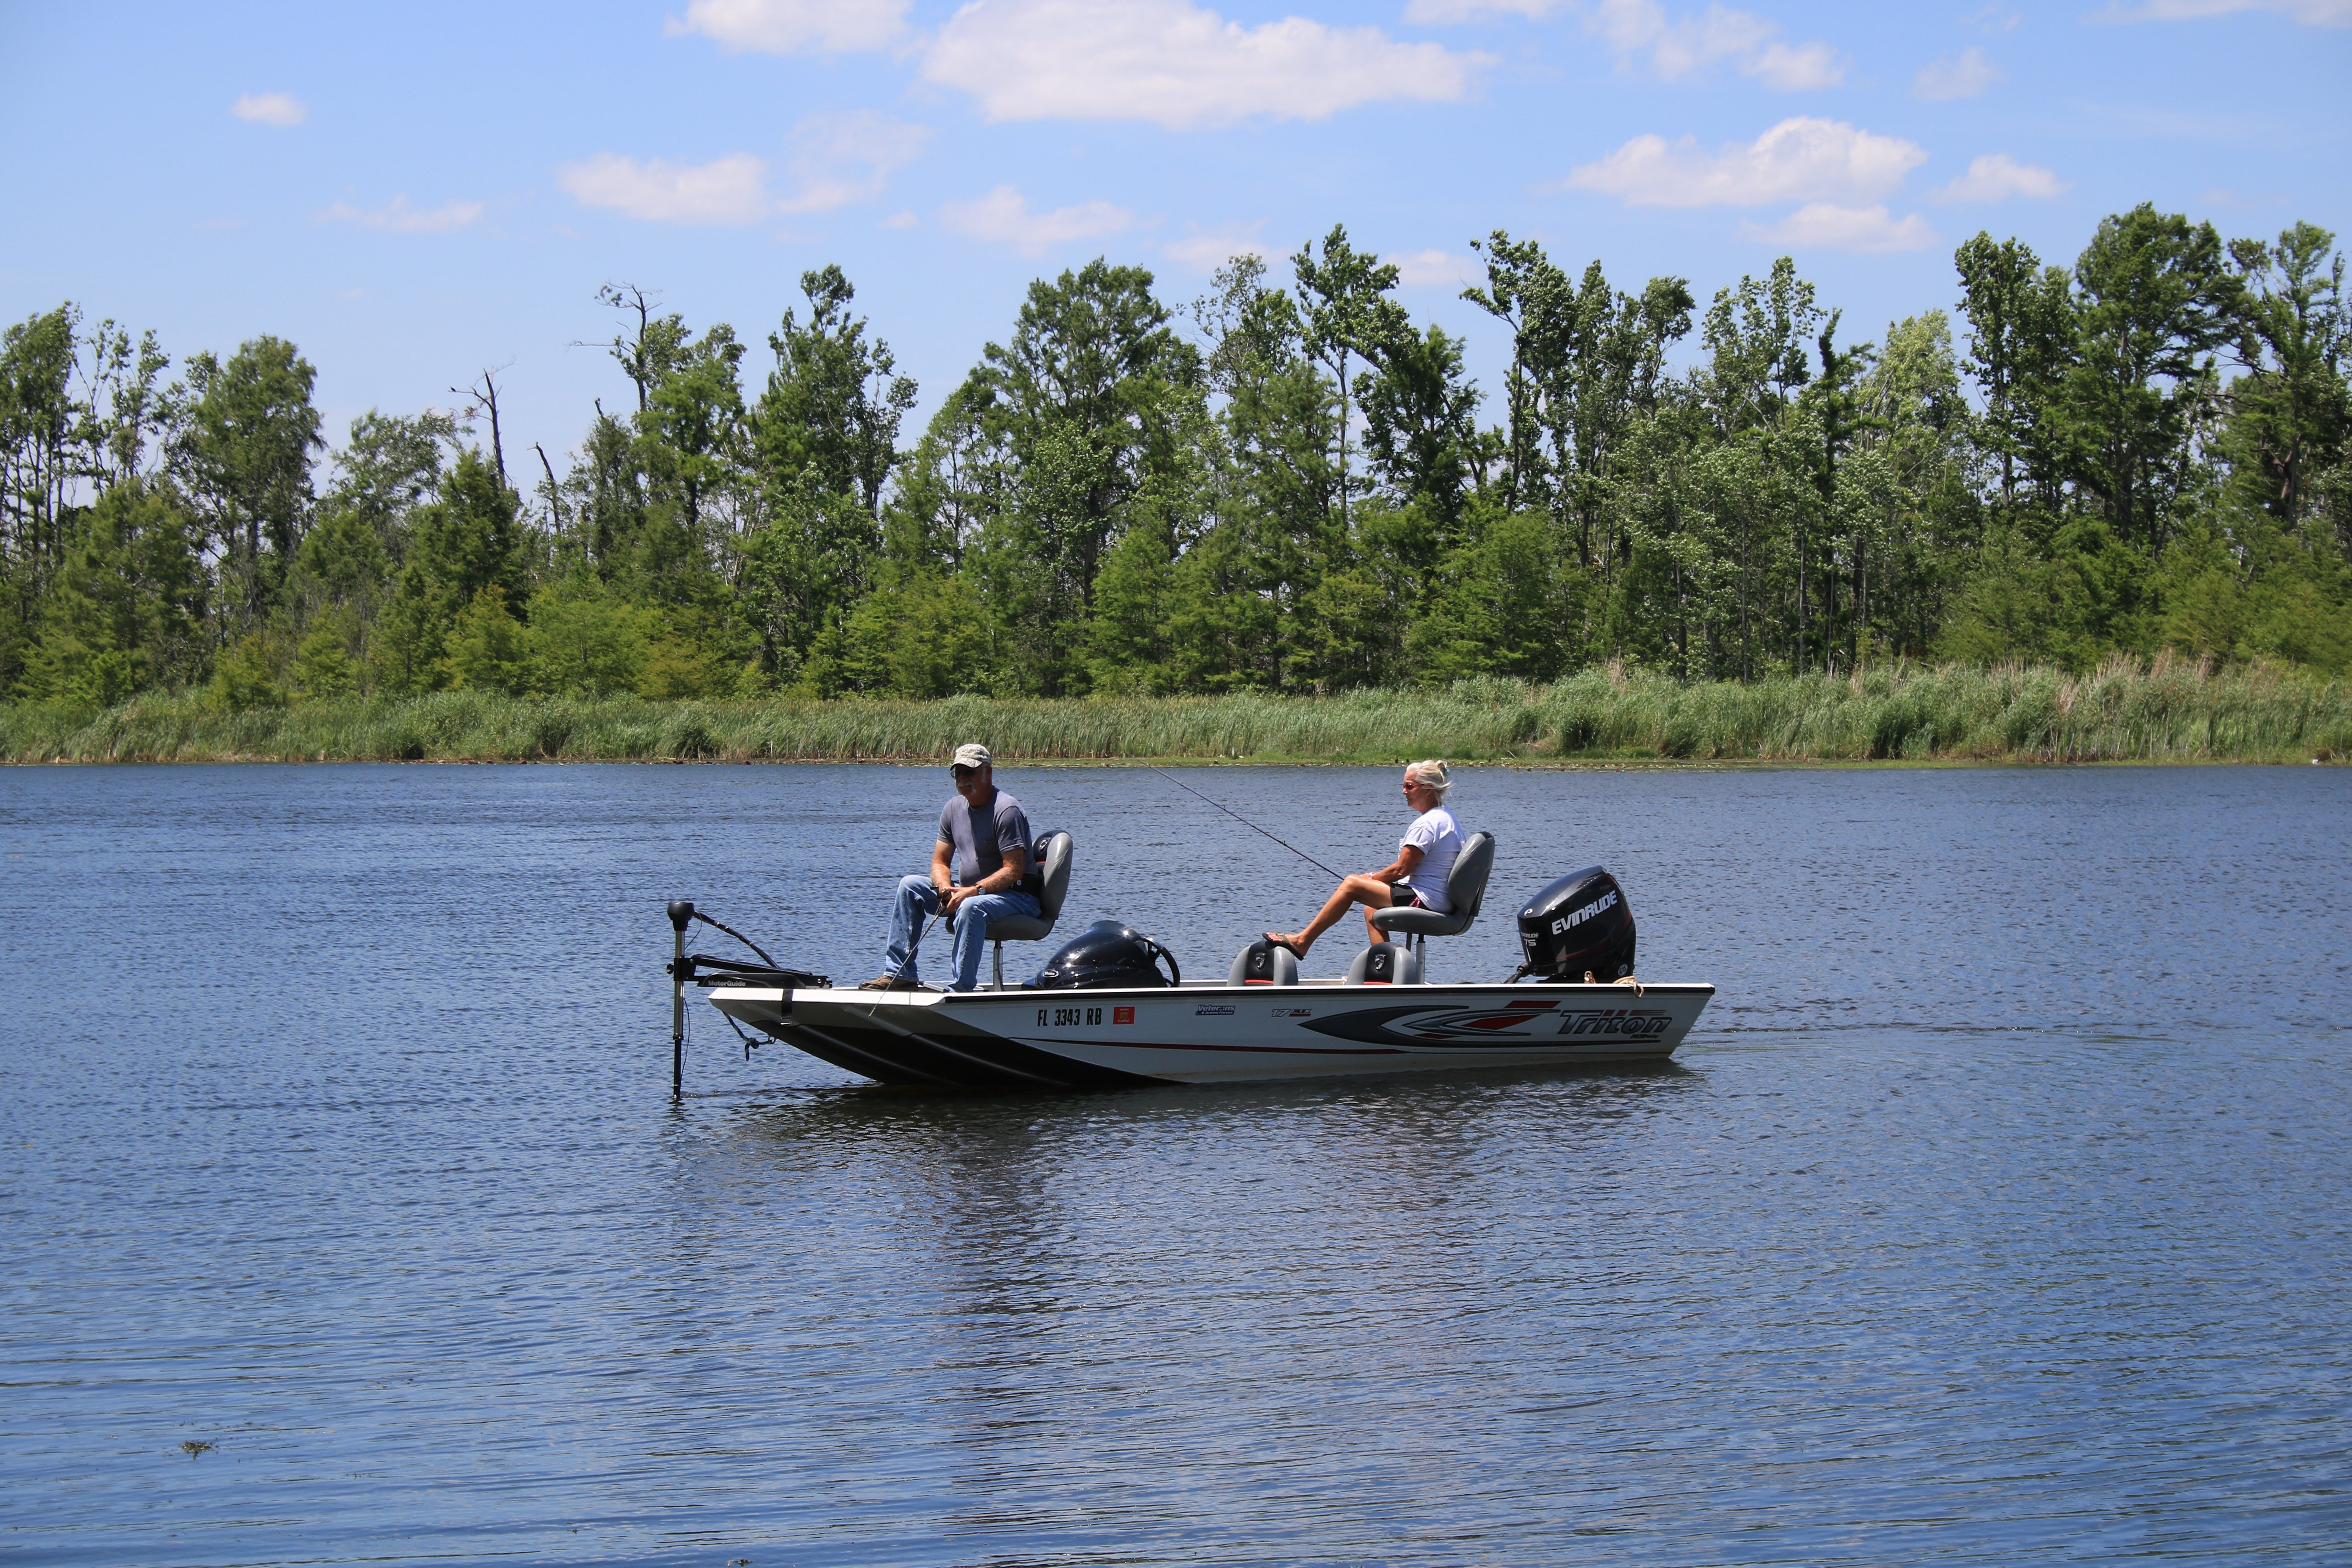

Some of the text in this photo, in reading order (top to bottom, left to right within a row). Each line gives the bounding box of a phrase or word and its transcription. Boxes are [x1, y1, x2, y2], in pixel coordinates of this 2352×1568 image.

[1552, 890, 1617, 935] EVINRUDE
[1037, 1008, 1102, 1027] FL 3343 RB
[1271, 1009, 1291, 1017] 17
[1557, 1010, 1672, 1034] Triton
